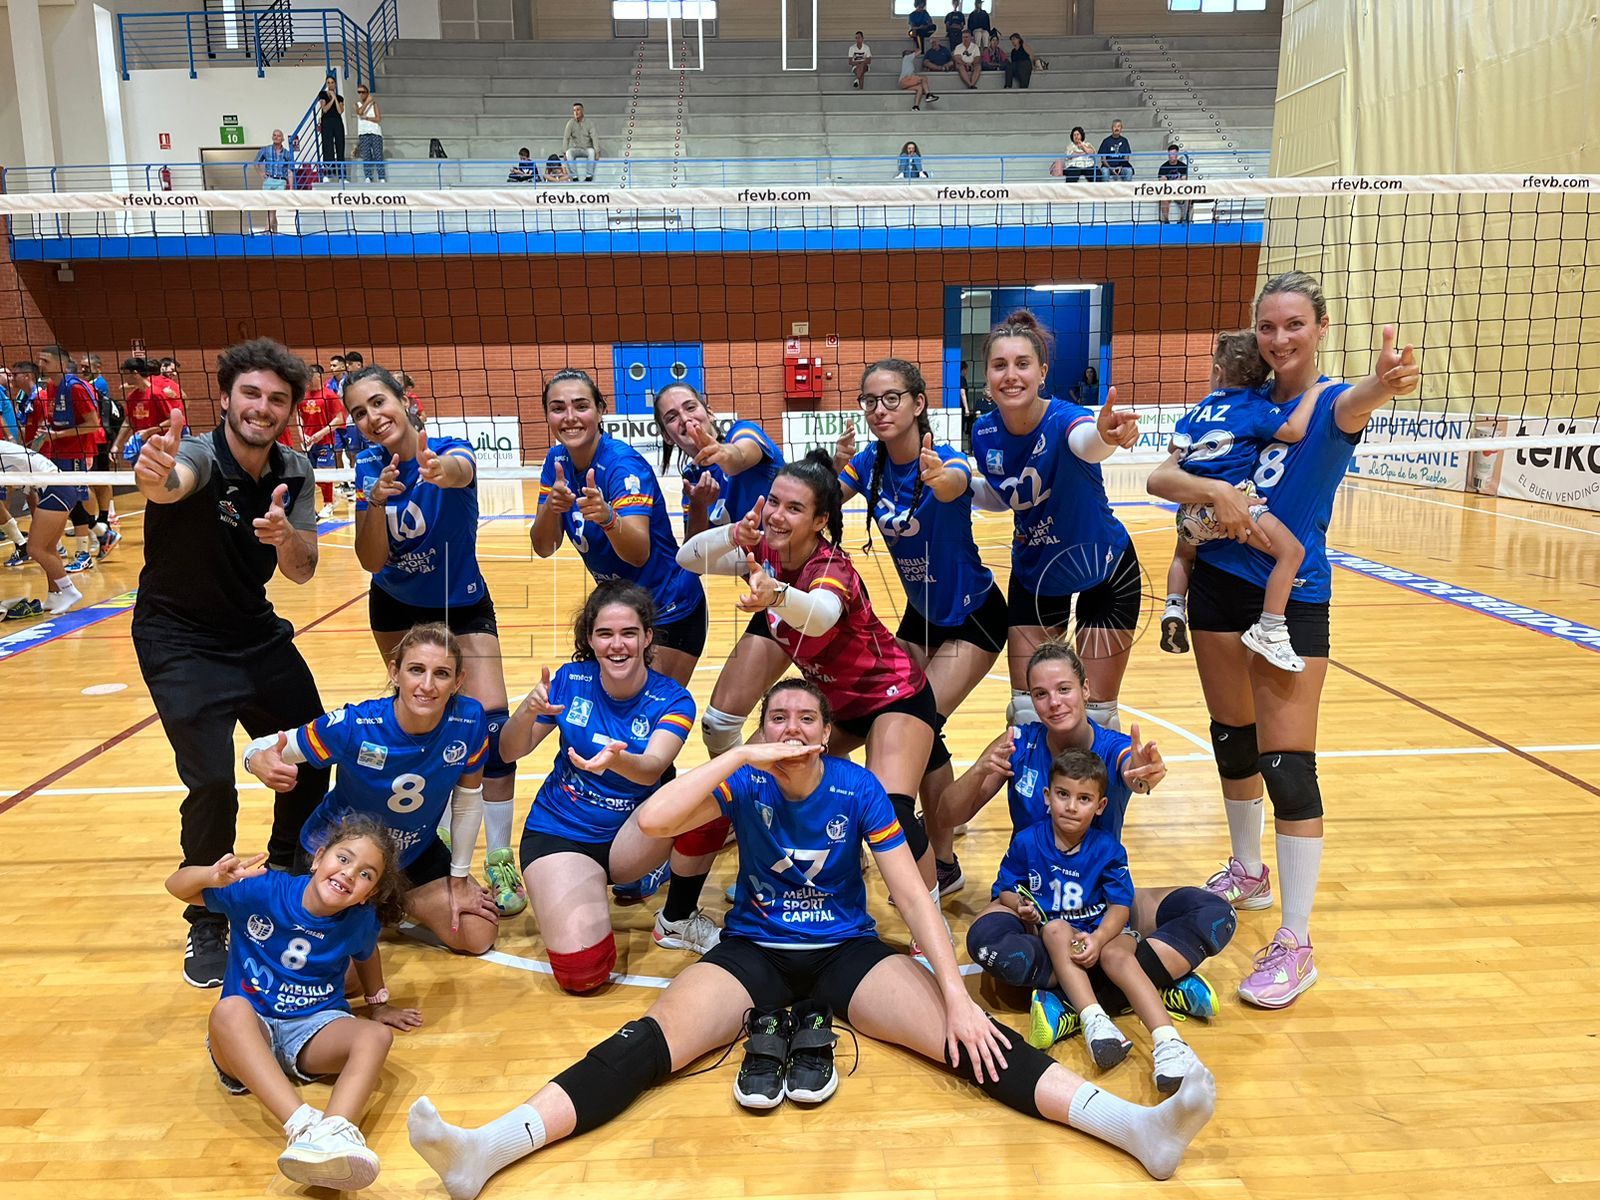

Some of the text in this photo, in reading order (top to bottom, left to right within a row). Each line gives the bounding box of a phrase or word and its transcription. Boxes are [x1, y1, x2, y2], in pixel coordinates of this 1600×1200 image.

[228, 134, 238, 144] 10
[1331, 178, 1403, 190] rfevb.com
[1523, 176, 1590, 188] rfevb.com
[738, 190, 811, 202] rfevb.com
[938, 187, 1009, 199] rfevb.com
[1134, 184, 1207, 196] rfevb.com
[123, 193, 199, 206] rfevb.com
[331, 193, 407, 205] rfevb.com
[536, 192, 610, 204] rfevb.com
[1366, 414, 1462, 440] DIPUTACIÓN
[1254, 442, 1289, 488] 8
[999, 466, 1052, 511] 22
[1528, 482, 1552, 500] BUEN
[1556, 482, 1600, 502] VENDING
[386, 772, 426, 814] 8
[1048, 878, 1084, 912] 18
[782, 898, 825, 910] SPORT
[782, 910, 836, 923] CAPITAL
[280, 937, 312, 971] 8
[278, 982, 335, 996] MELILLA
